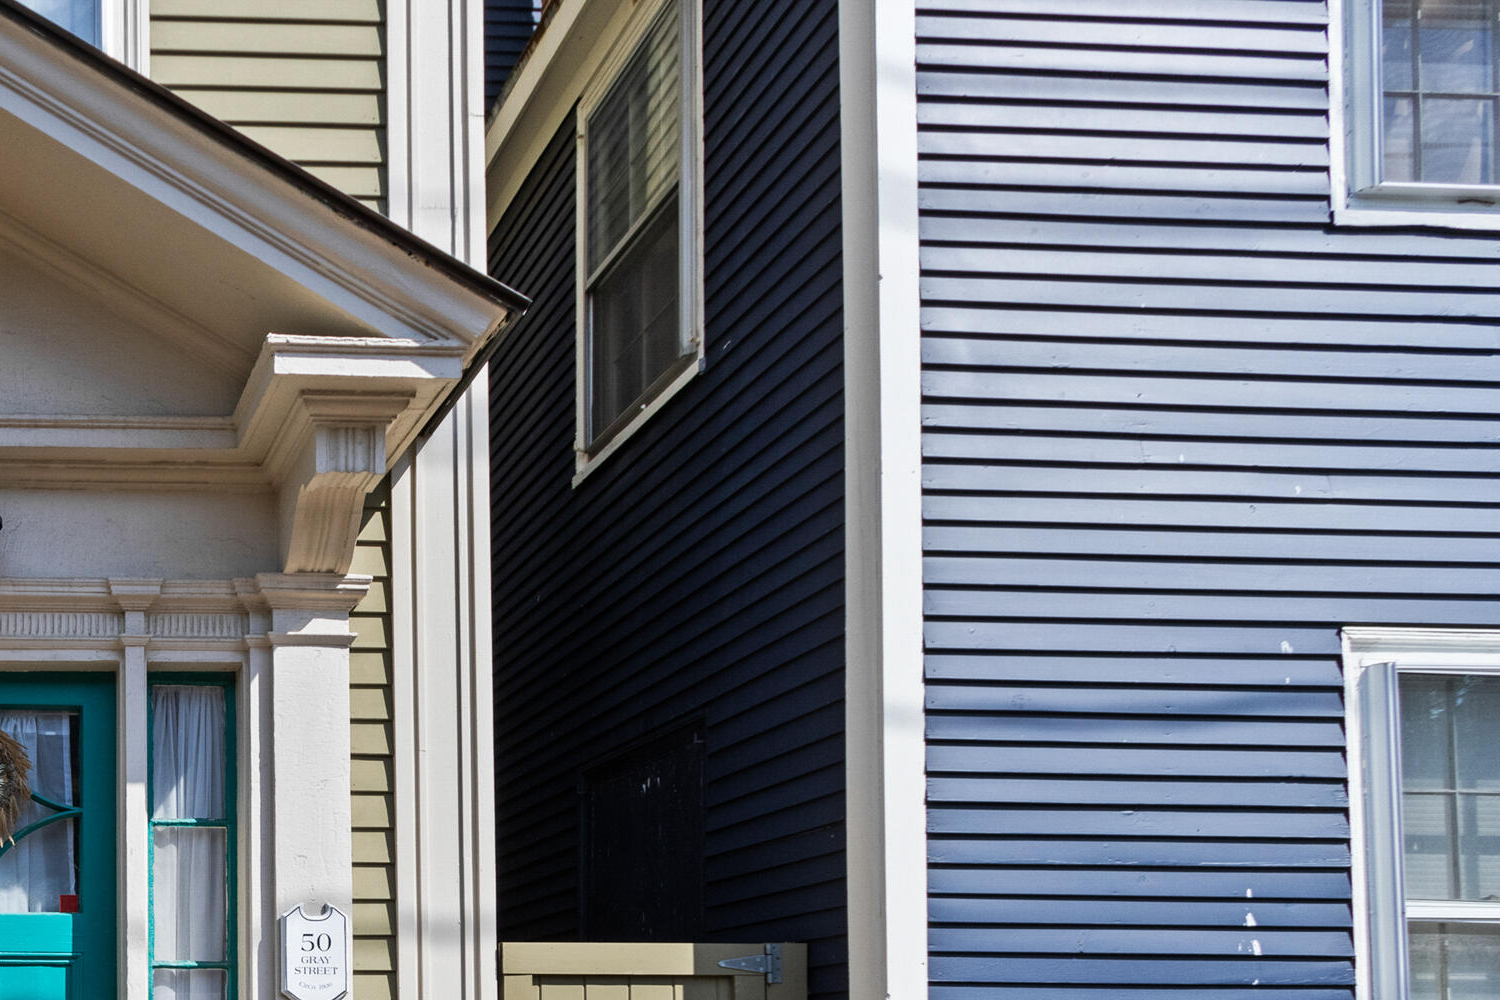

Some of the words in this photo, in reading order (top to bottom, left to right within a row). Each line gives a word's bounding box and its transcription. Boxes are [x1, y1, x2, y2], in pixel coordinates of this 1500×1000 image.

[301, 933, 332, 952] 50
[301, 956, 331, 964] GRAY
[294, 966, 338, 975] STREET
